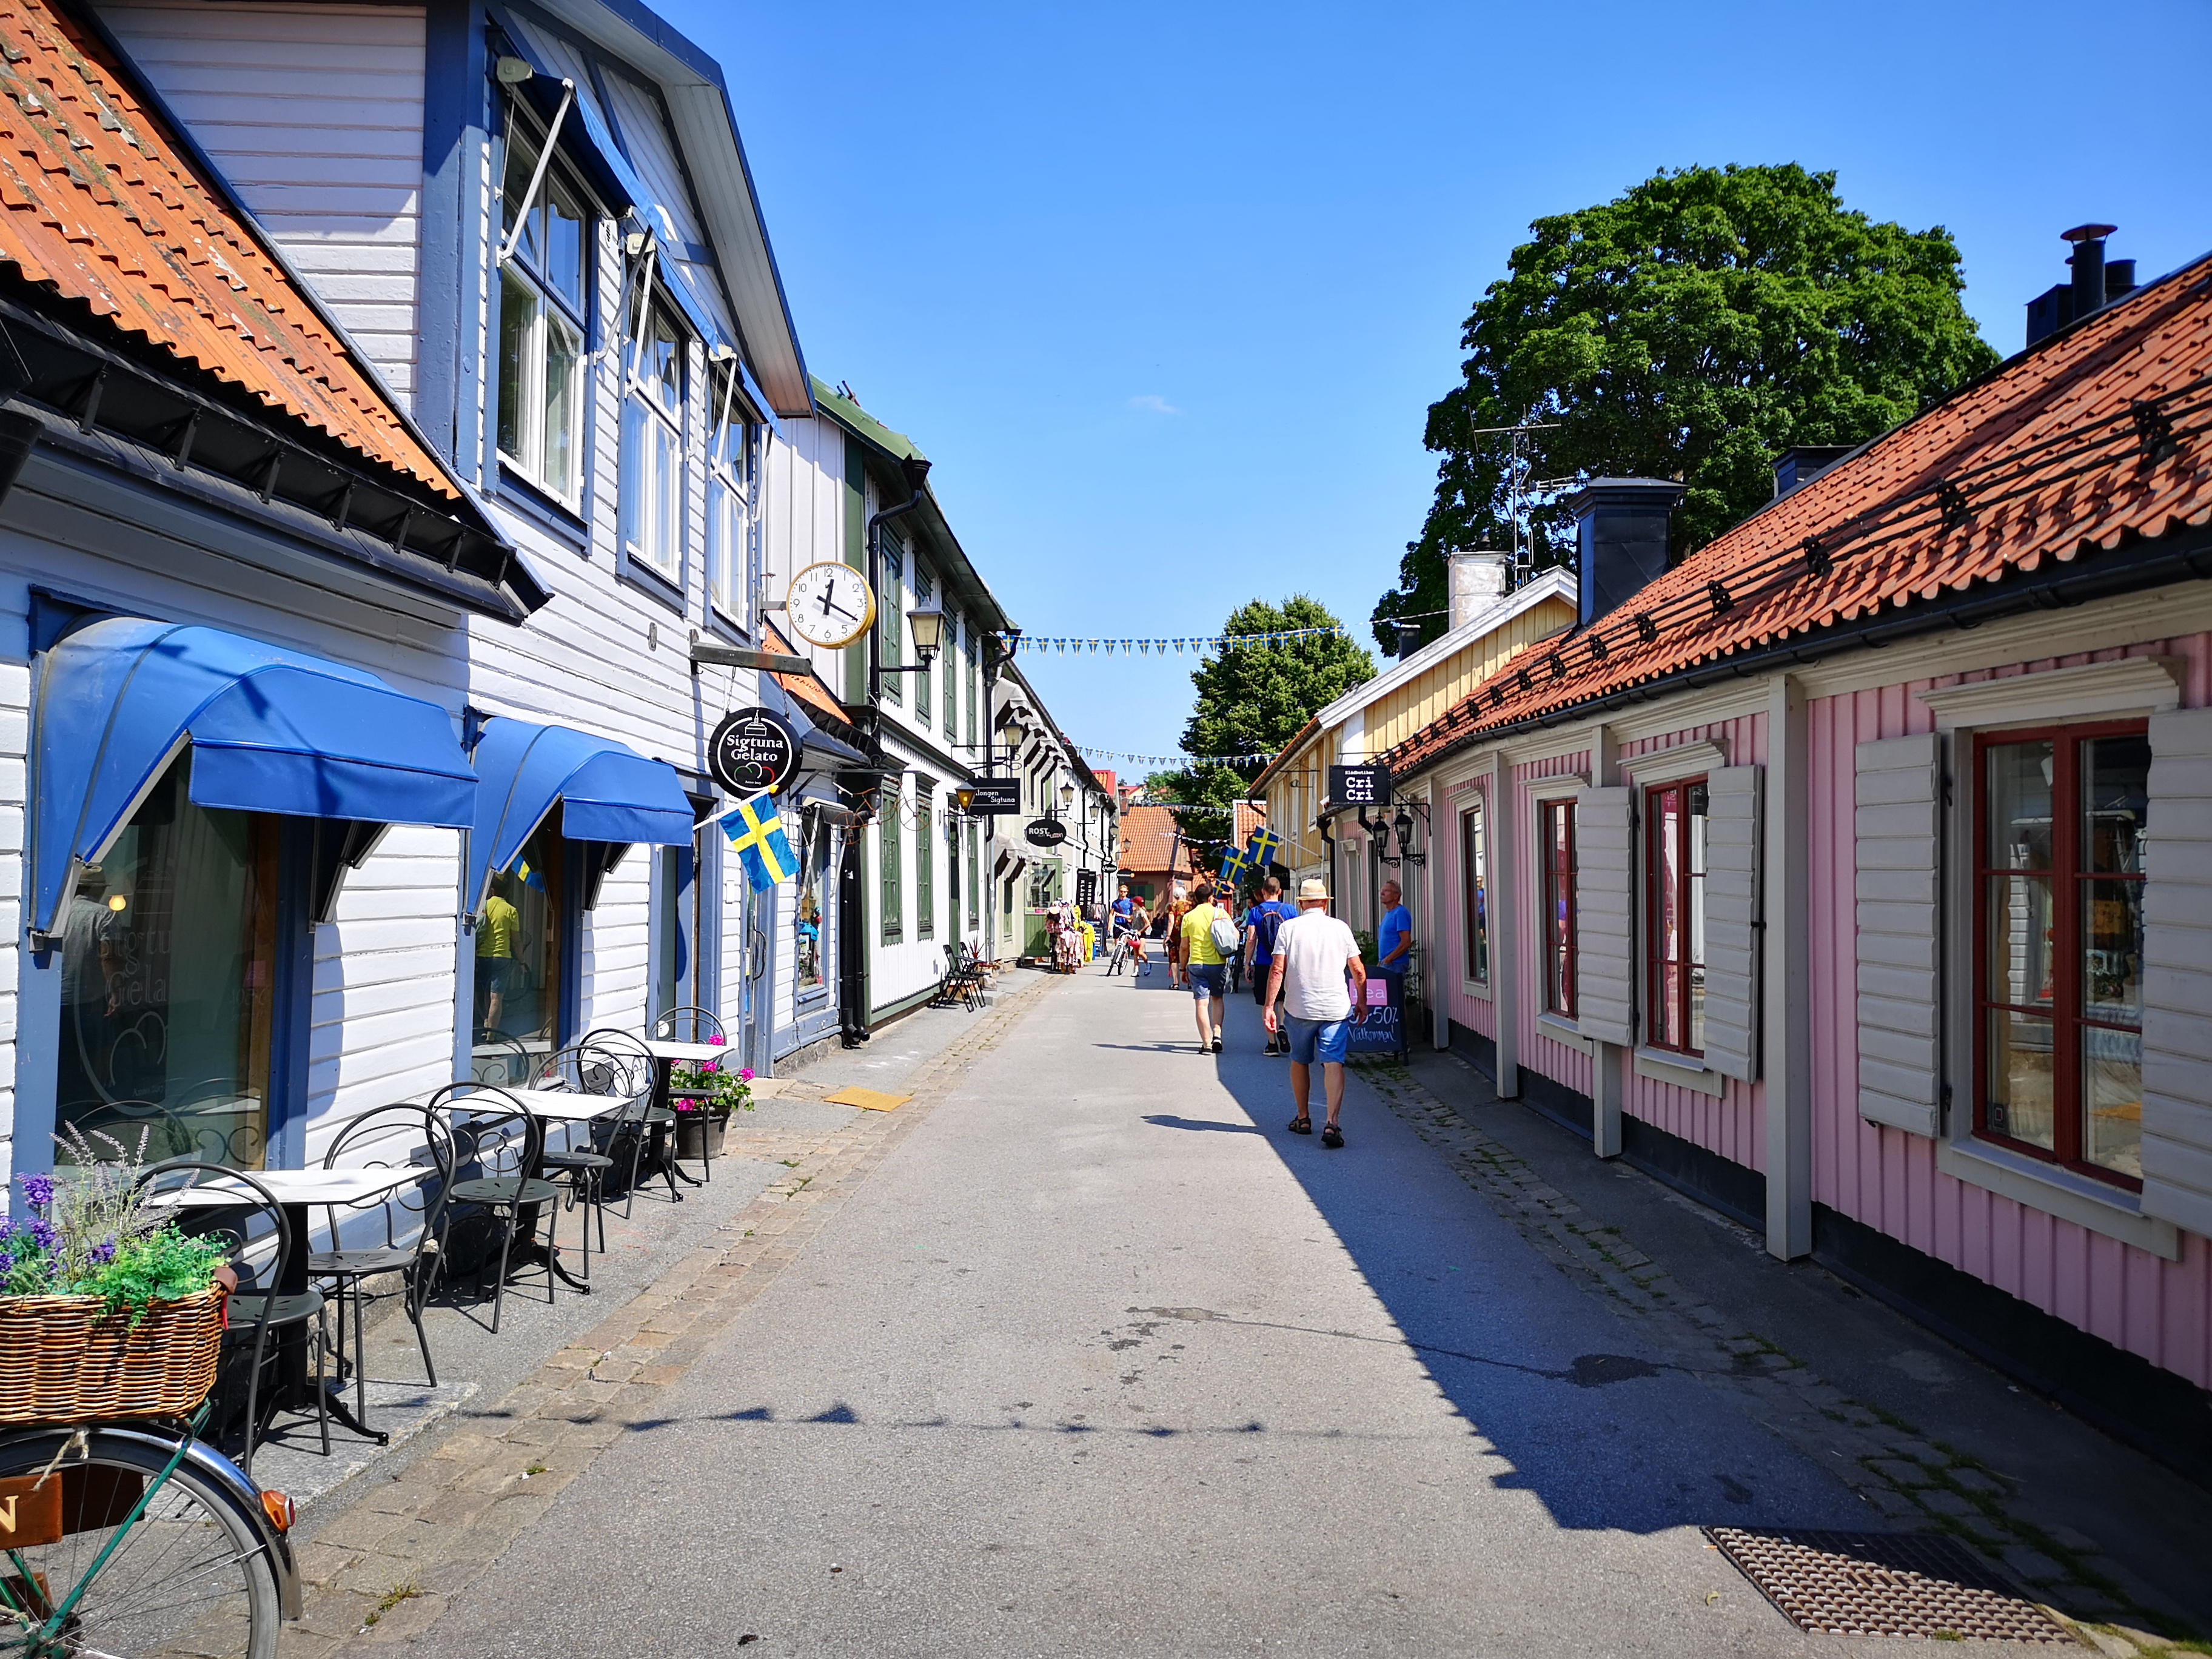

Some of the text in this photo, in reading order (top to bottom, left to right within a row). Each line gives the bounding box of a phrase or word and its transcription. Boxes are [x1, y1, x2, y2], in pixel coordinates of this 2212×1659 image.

[810, 572, 817, 581] 11
[824, 568, 833, 577] 12
[799, 583, 807, 592] 10
[852, 583, 859, 592] 2
[793, 598, 800, 608] 9
[857, 598, 863, 608] 3
[797, 614, 804, 623] 8
[809, 625, 816, 634] 7
[824, 629, 831, 638] 6
[841, 625, 848, 634] 5
[727, 734, 783, 751] Sigtuna
[731, 748, 778, 762] Gelato
[1346, 776, 1374, 788] Cri
[976, 789, 999, 797] longen
[1346, 789, 1374, 800] Cri
